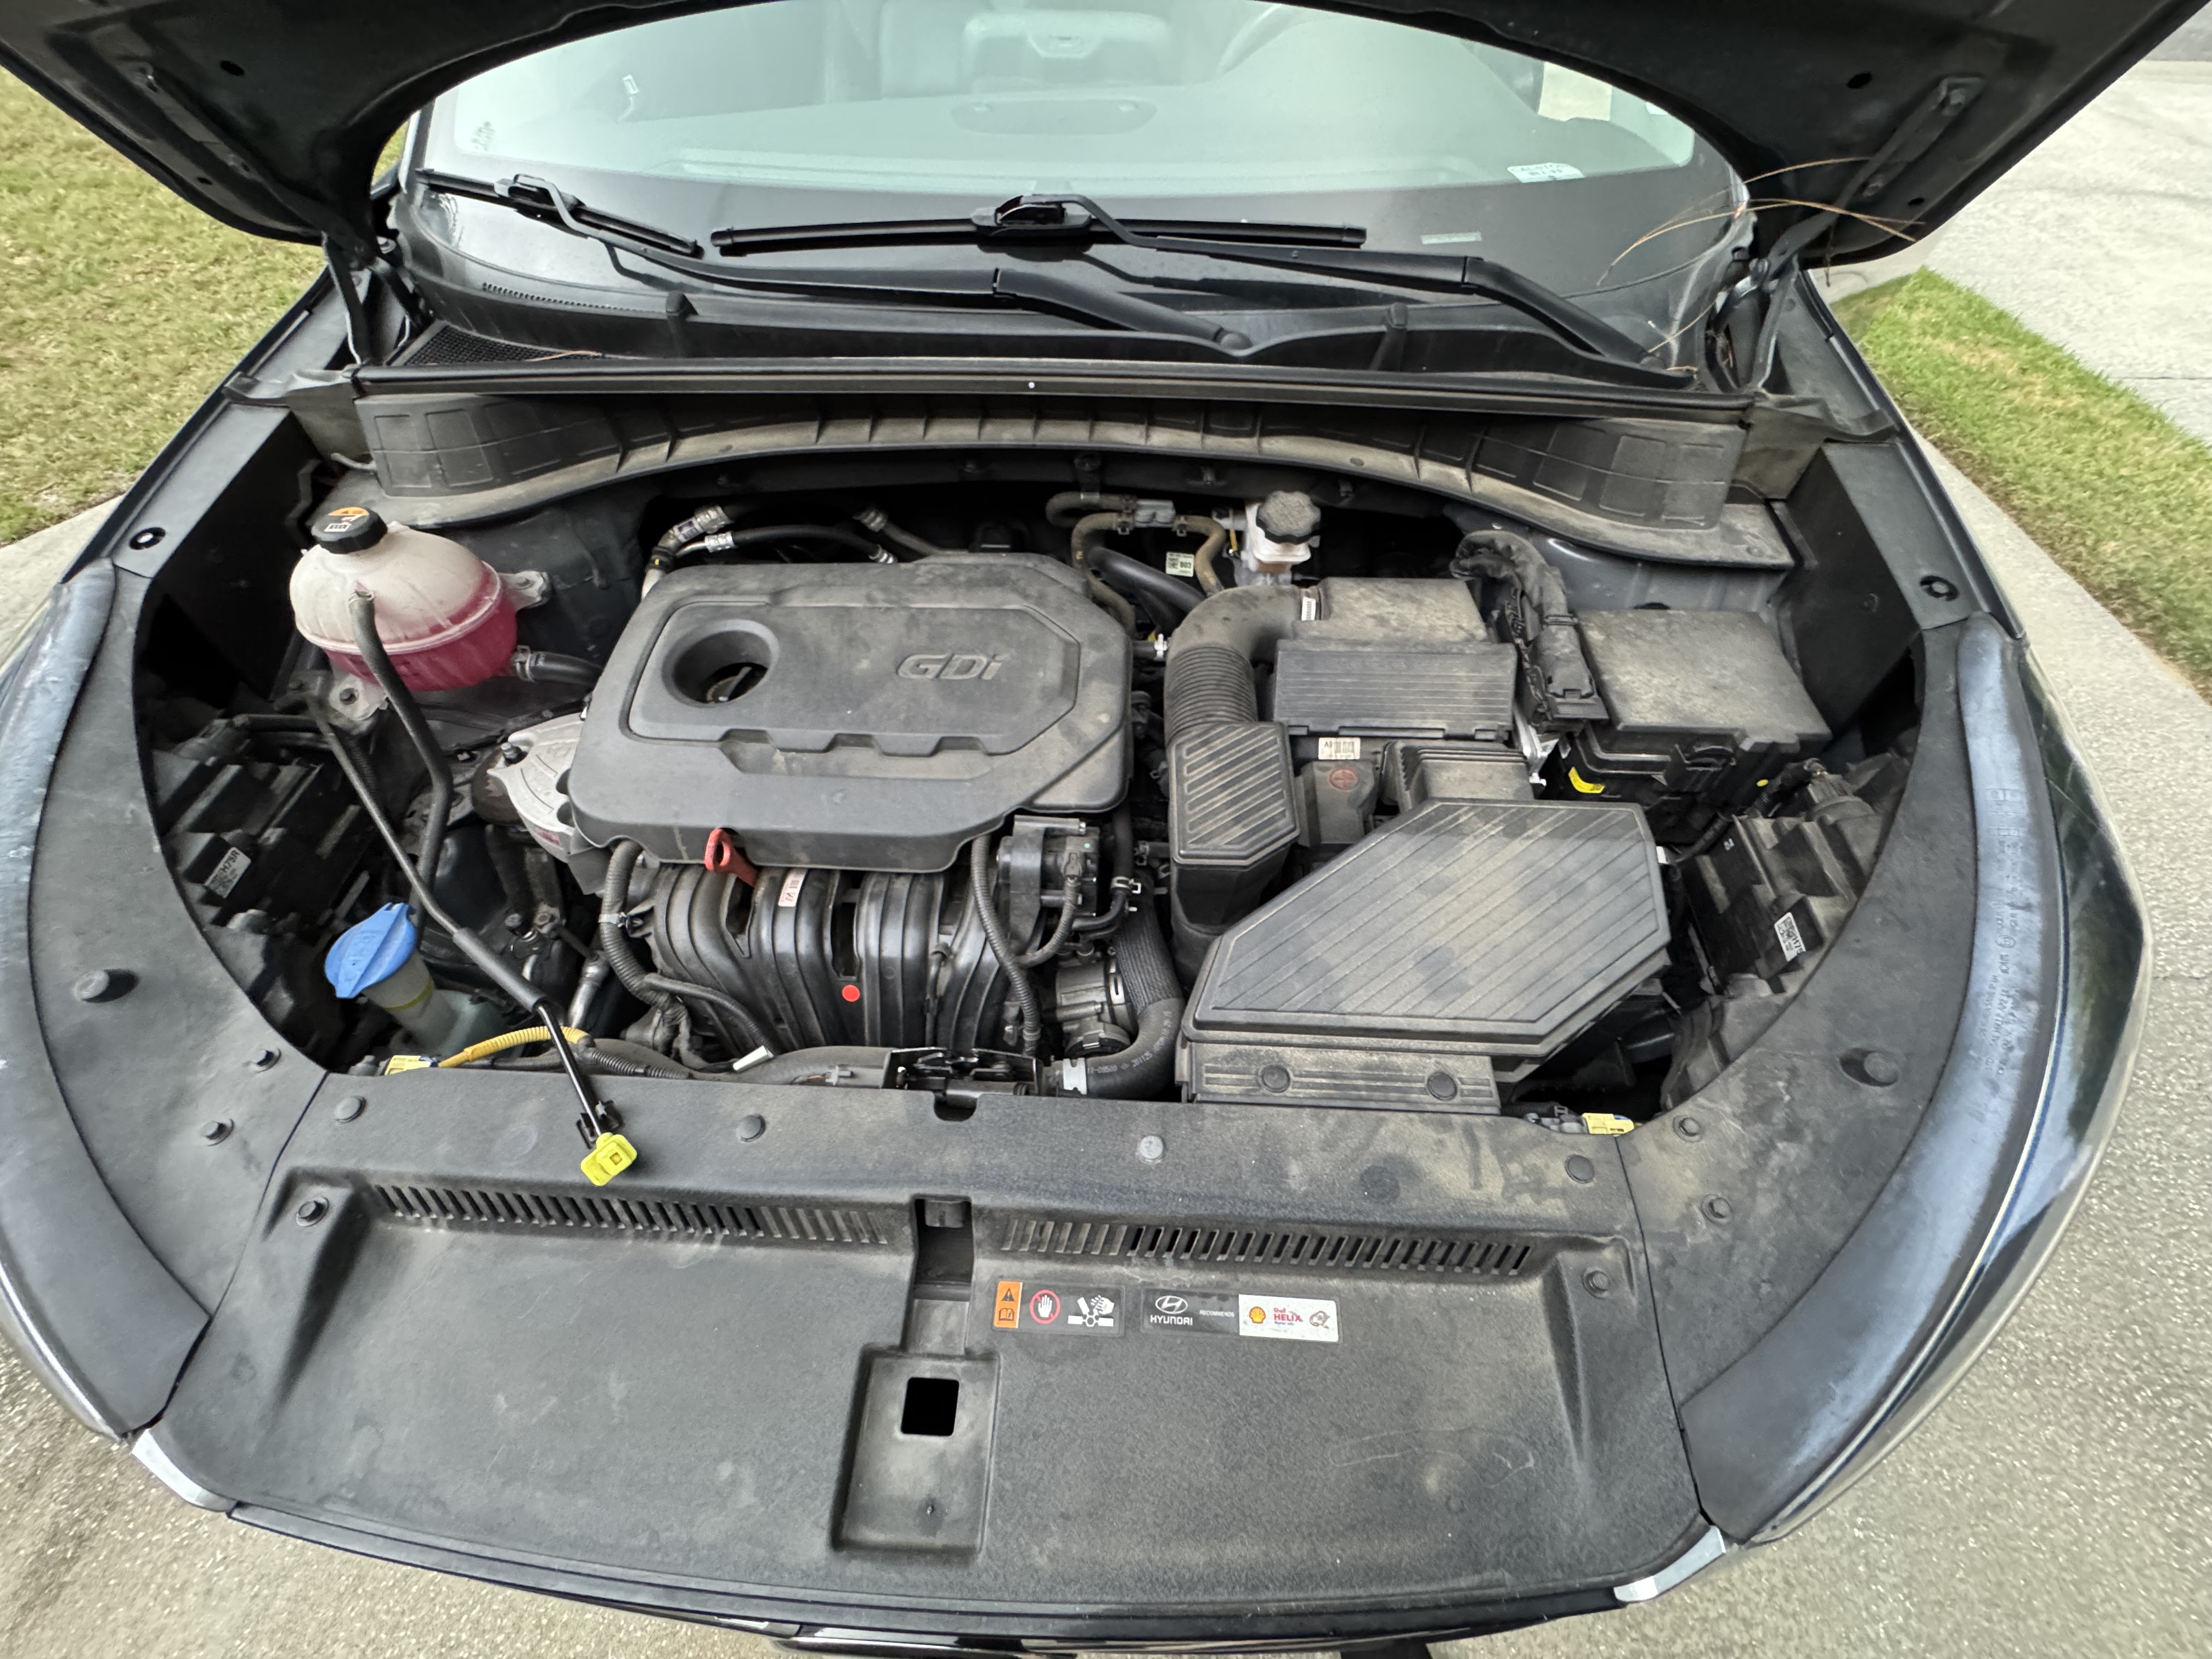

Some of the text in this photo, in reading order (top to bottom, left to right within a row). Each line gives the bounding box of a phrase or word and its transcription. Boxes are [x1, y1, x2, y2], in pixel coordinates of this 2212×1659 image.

[897, 652, 1009, 680] GDi
[1150, 1315, 1193, 1326] HYUNDAI
[1274, 1313, 1303, 1322] HELIX
